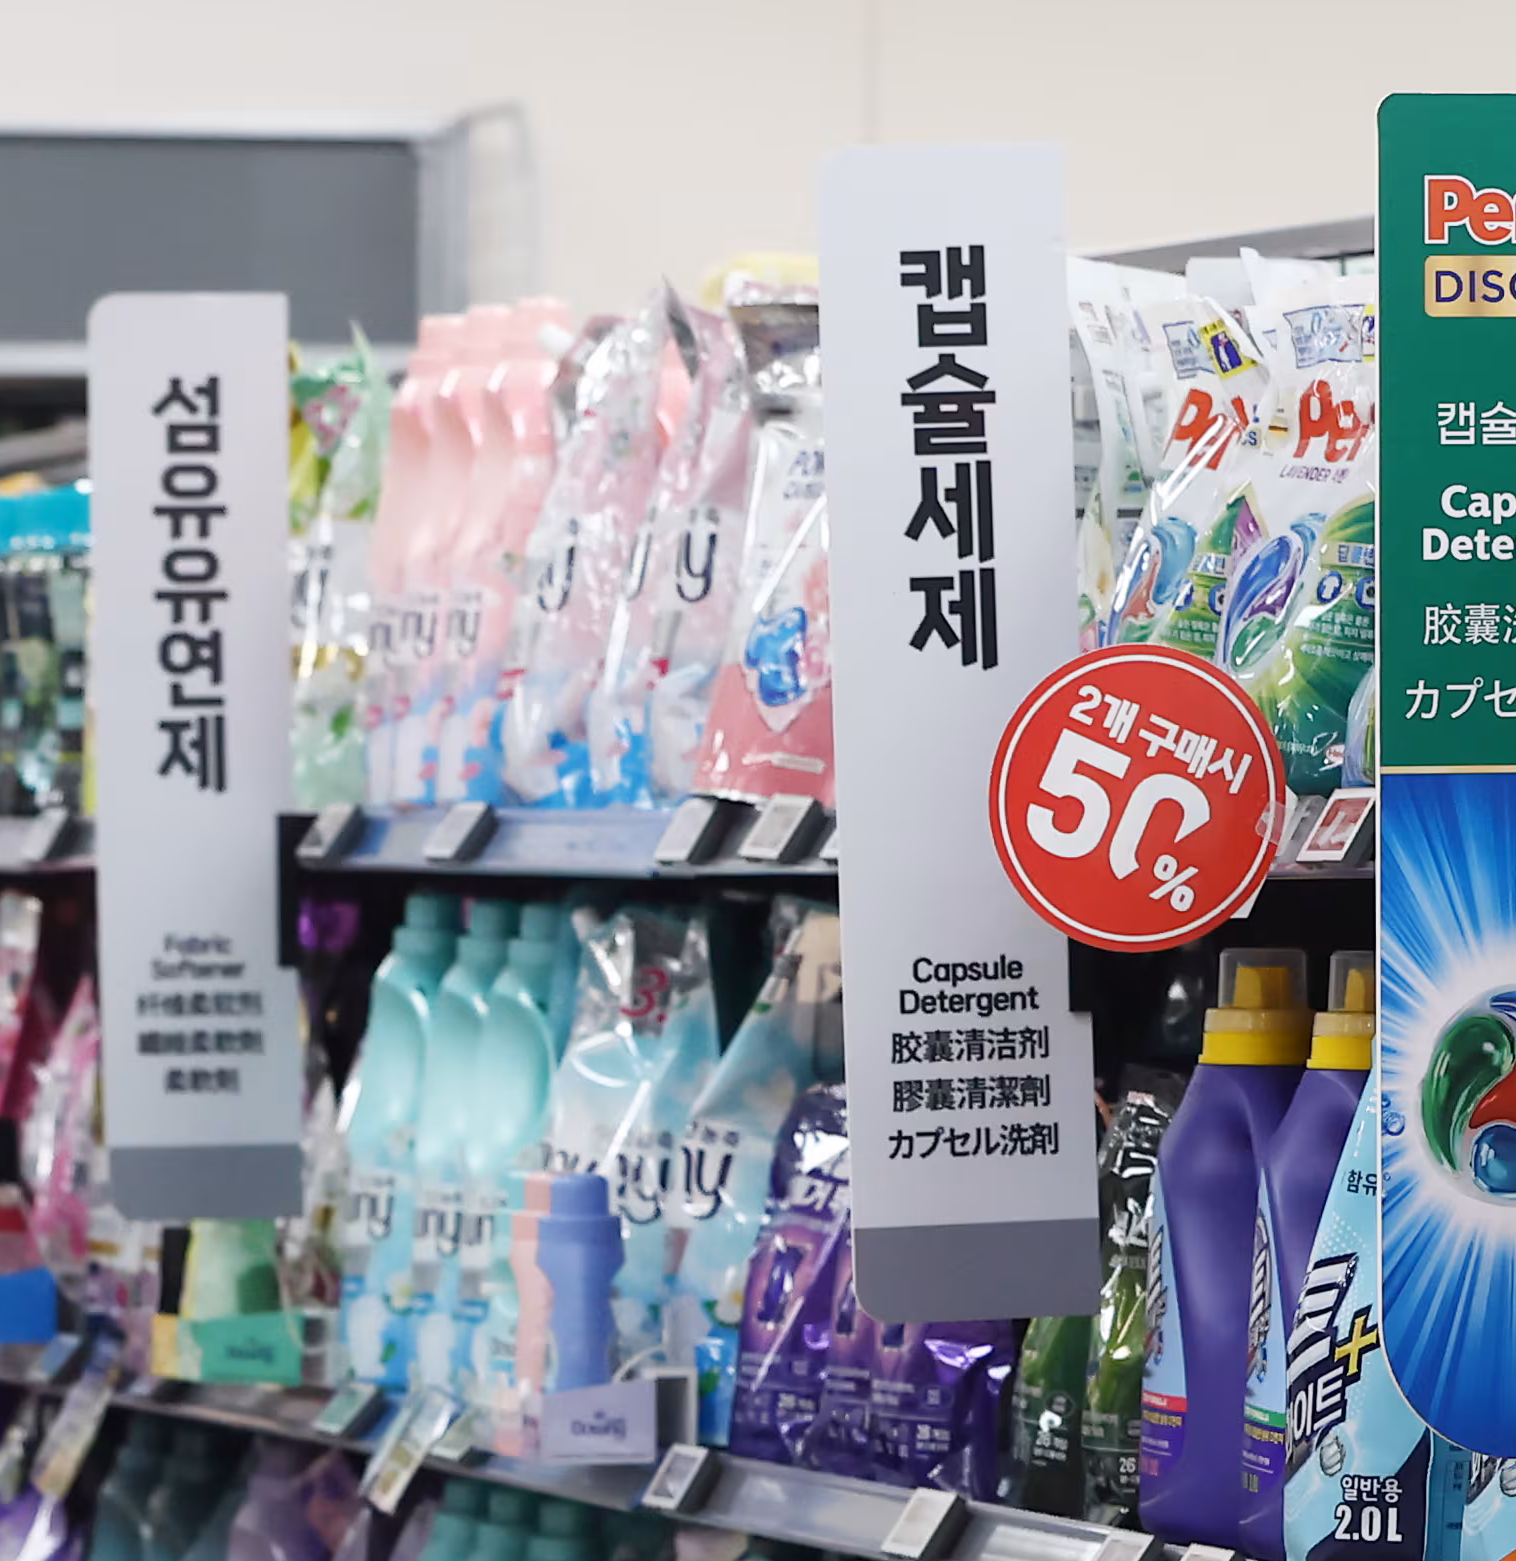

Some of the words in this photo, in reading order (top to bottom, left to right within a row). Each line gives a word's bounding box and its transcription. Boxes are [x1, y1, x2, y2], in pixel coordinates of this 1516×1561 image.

[898, 244, 999, 671] 캡슐세제
[151, 375, 230, 794] 섬유유연제
[1068, 684, 1141, 746] 2개
[1138, 714, 1253, 795] 구매시
[912, 954, 1023, 987] Capsule
[898, 985, 1040, 1018] Detergent
[891, 1025, 1049, 1065] 胶囊清洁剂
[891, 1074, 1051, 1113] 膠囊清潔劑
[887, 1122, 1060, 1160] カプセル洗剤
[1341, 1475, 1403, 1503] 일반용
[1334, 1505, 1404, 1543] 2.0L
